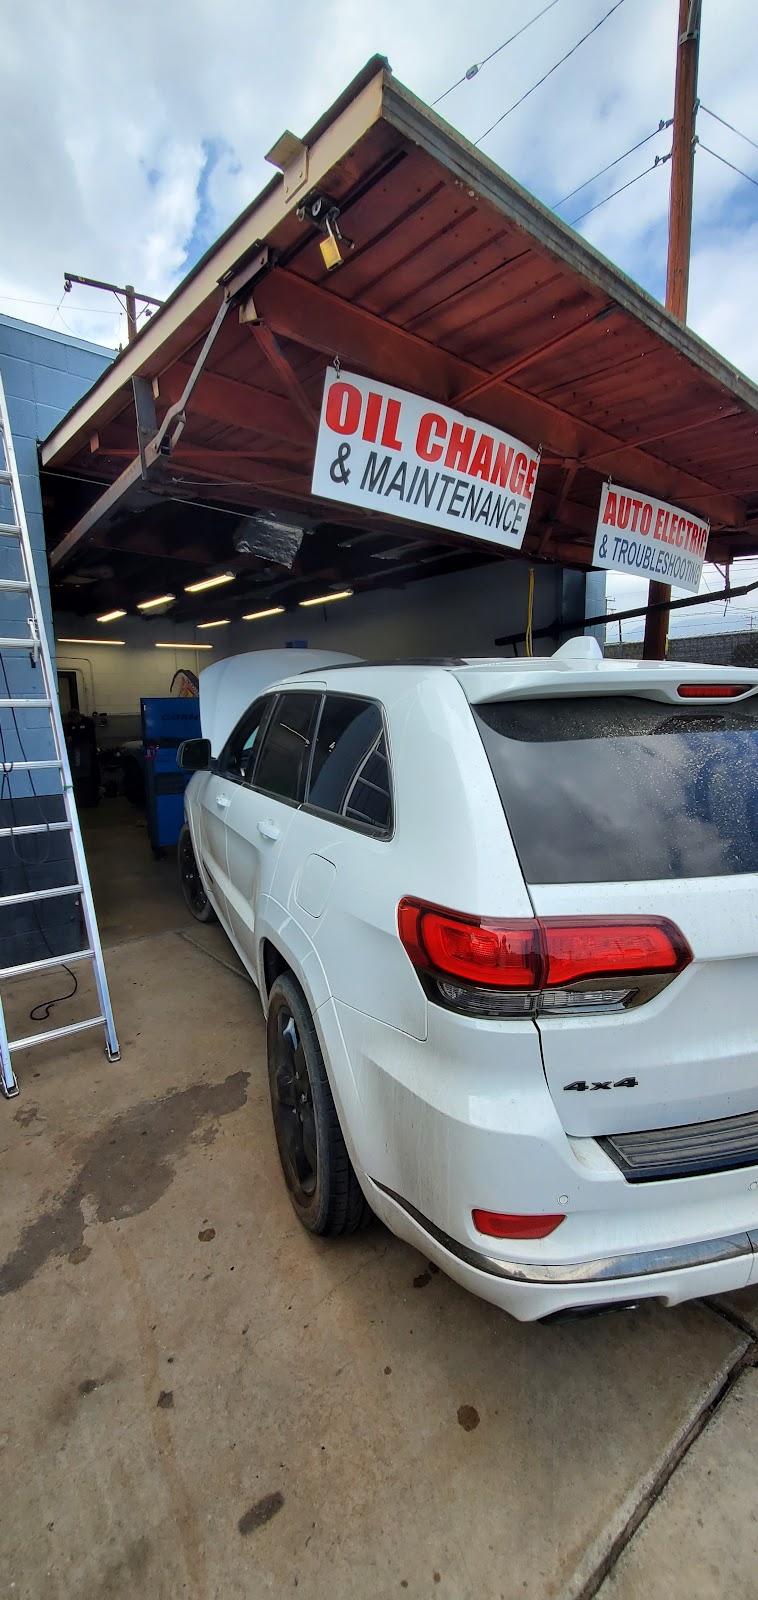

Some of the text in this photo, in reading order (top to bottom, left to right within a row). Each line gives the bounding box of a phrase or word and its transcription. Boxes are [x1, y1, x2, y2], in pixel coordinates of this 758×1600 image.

[325, 382, 538, 499] OIL CHANGE
[329, 442, 526, 535] & MAINTENANCE
[602, 491, 708, 558] AUTO ELECTRIC
[598, 533, 701, 585] & TROUBLESHOOTING
